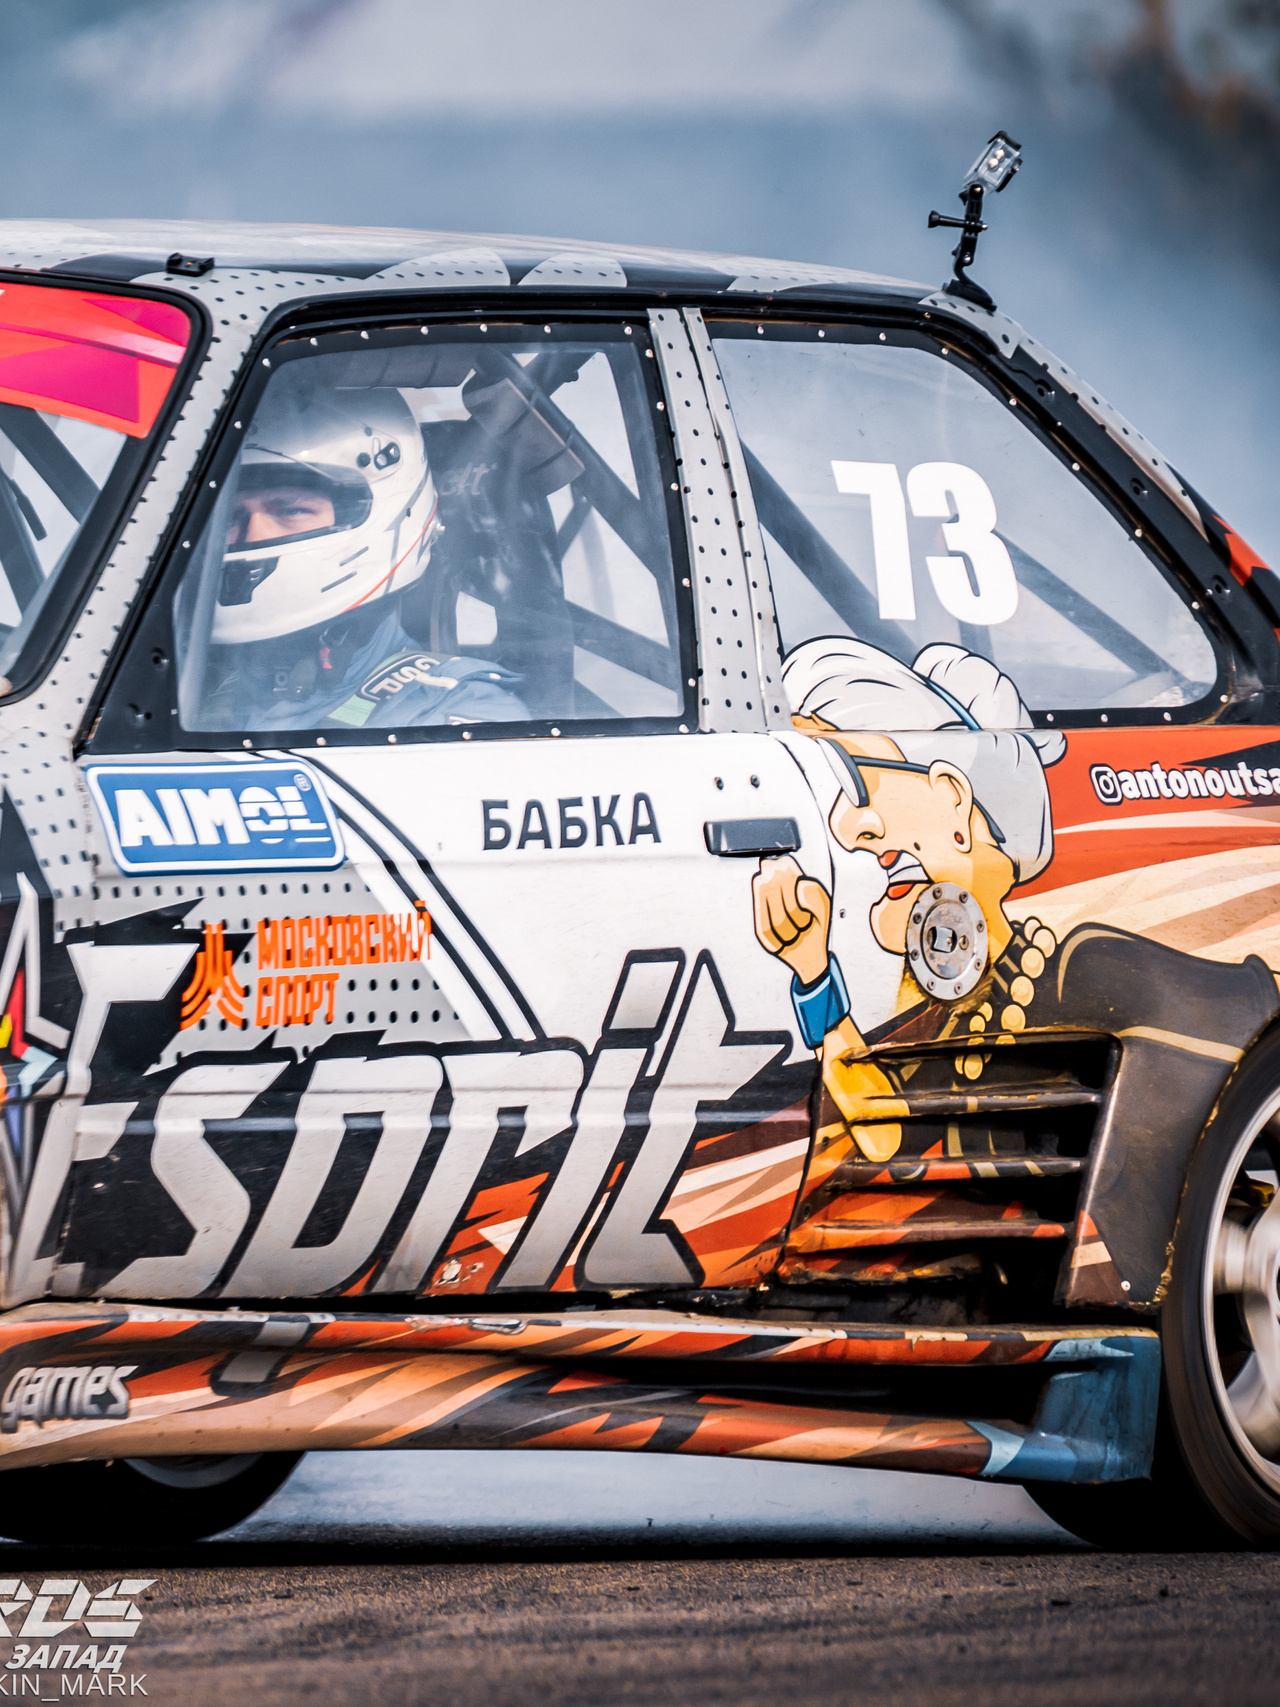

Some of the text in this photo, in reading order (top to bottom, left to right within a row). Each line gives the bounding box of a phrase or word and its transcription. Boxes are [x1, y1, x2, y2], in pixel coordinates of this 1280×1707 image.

[831, 459, 1019, 626] 73
[114, 786, 331, 848] AIMOL
[482, 792, 662, 851] БАБКА
[256, 900, 432, 970] МОСКОВСКИЙ
[255, 972, 340, 1027] СПОРТ
[1, 1364, 139, 1428] games
